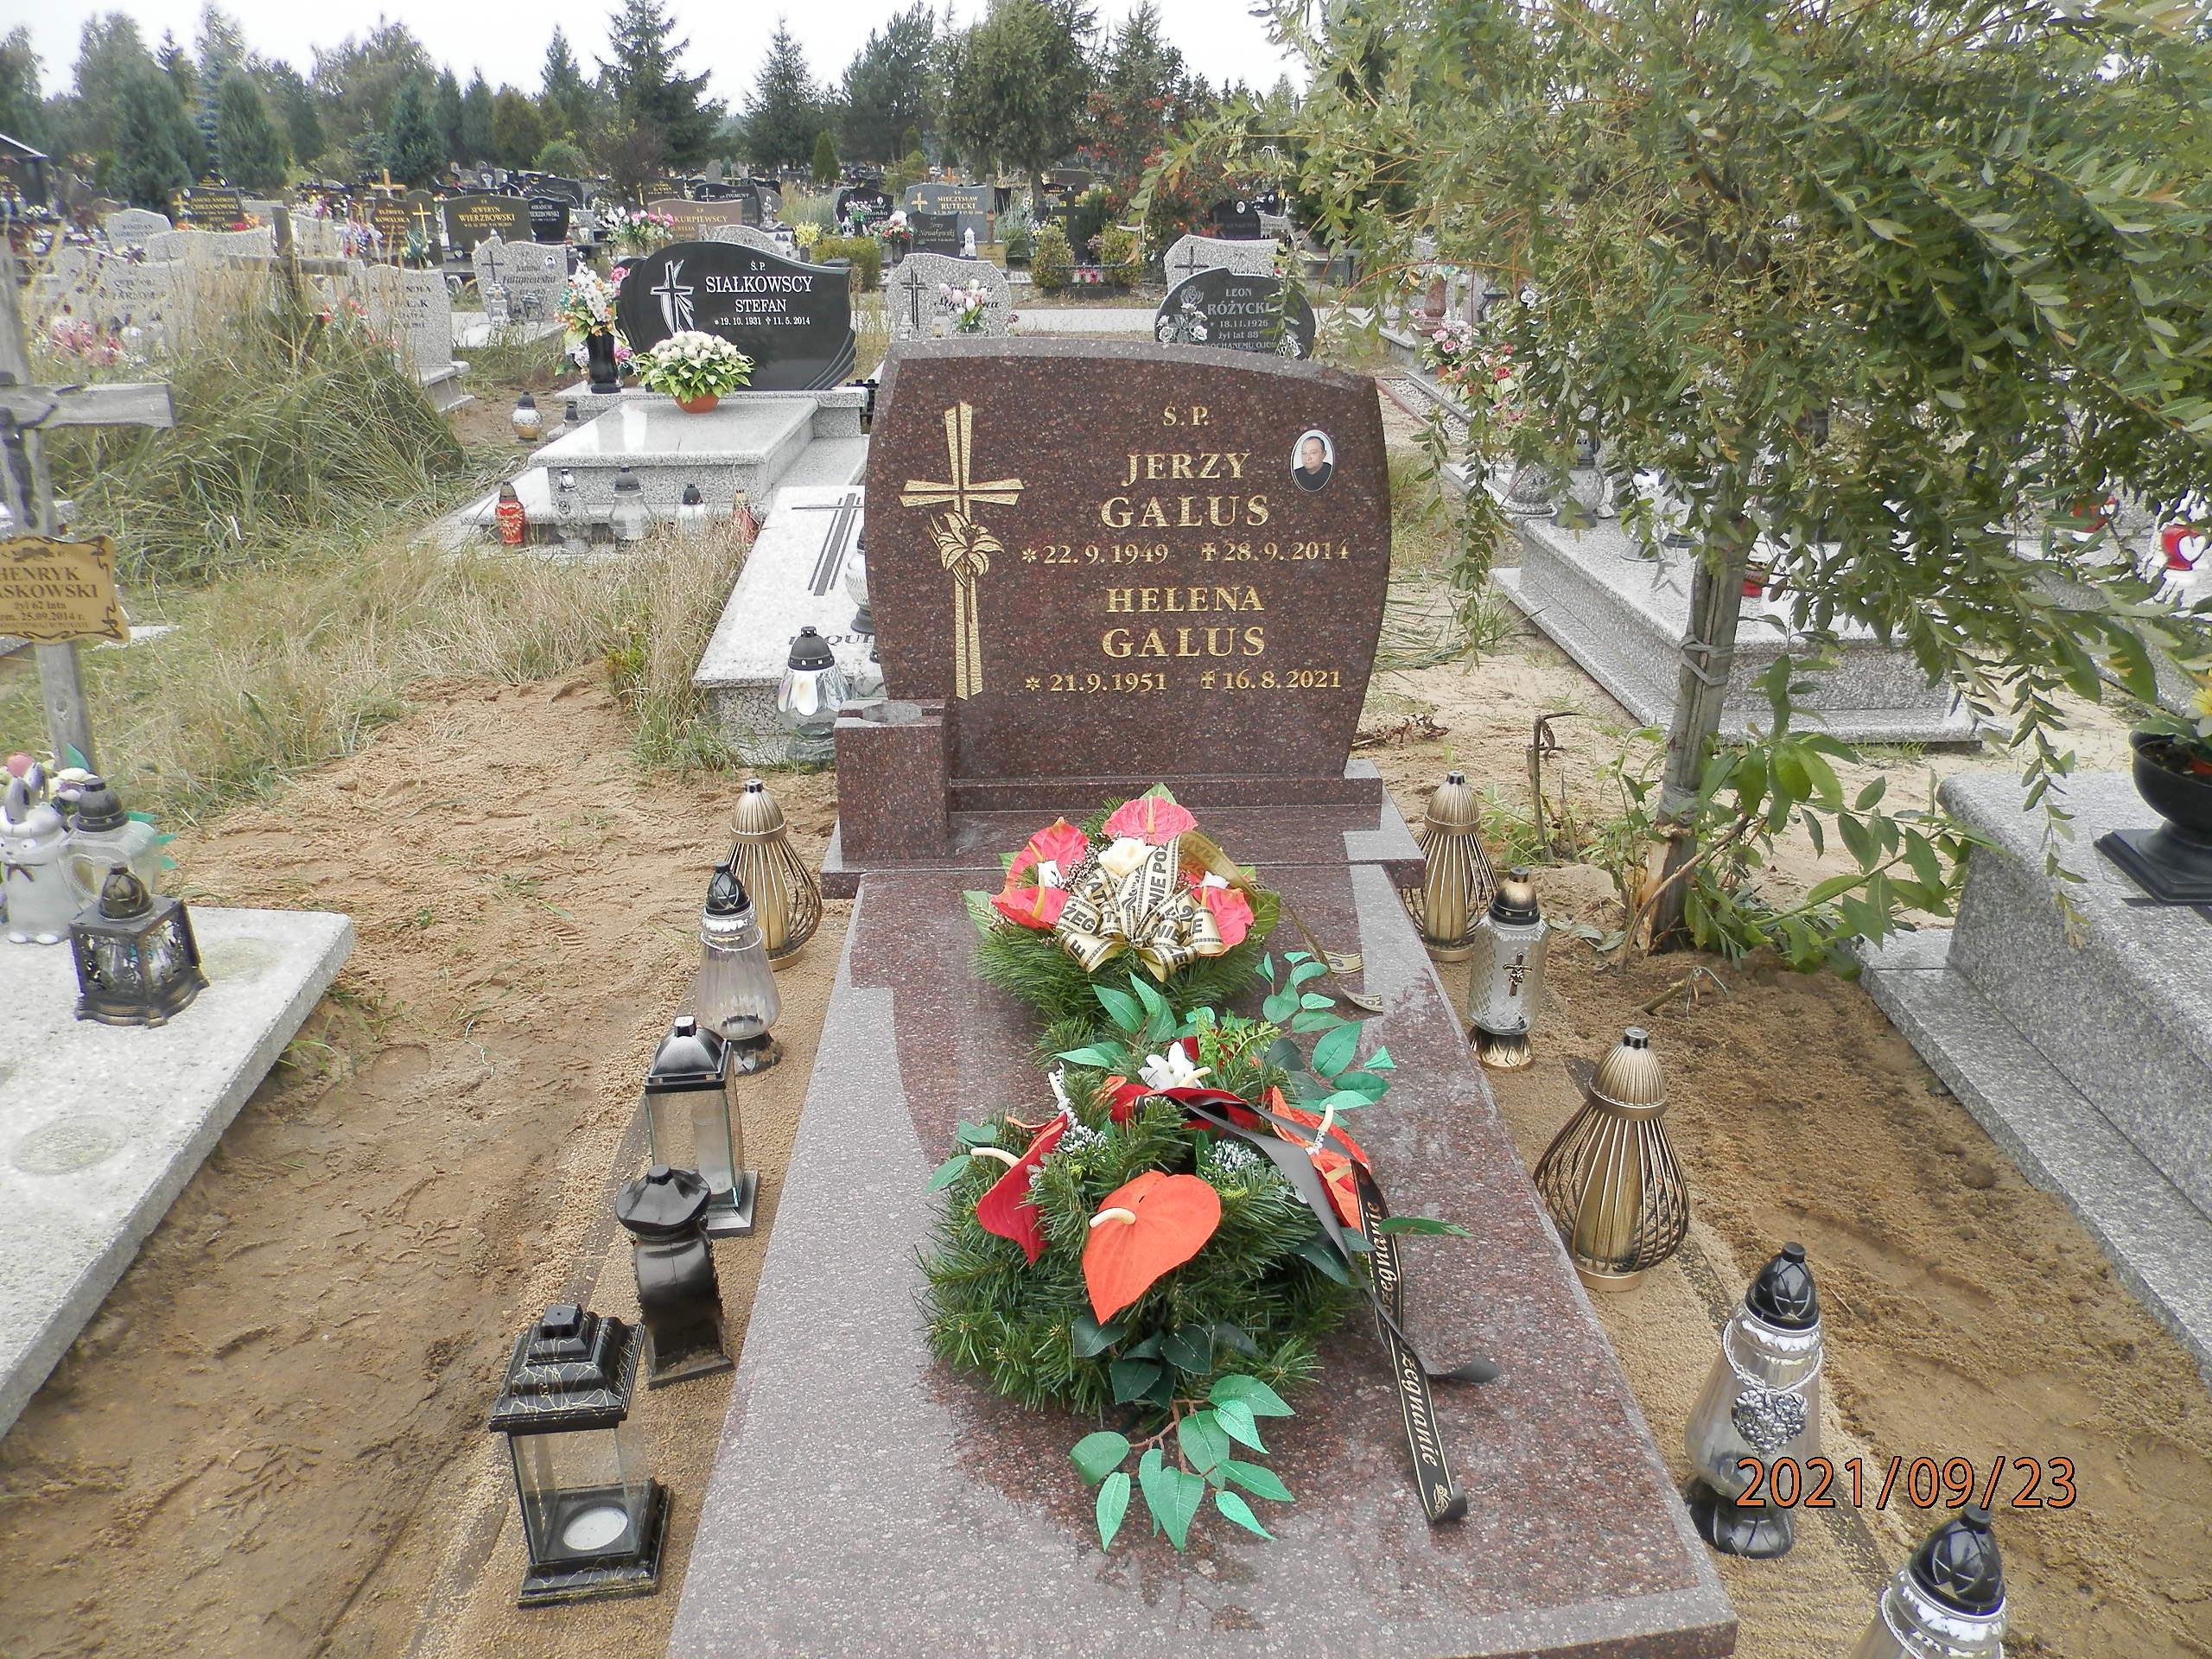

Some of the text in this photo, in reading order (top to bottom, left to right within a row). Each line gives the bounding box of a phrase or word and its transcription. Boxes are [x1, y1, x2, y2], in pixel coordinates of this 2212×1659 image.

[458, 213, 516, 222] WIERZBOWSKI
[1225, 288, 1252, 297] LEON
[735, 299, 786, 313] STEFAN
[1207, 300, 1270, 315] RÓŻYCKI
[1233, 331, 1244, 340] lat
[1247, 330, 1259, 339] 88
[1121, 452, 1252, 487] JERZY
[1100, 494, 1271, 529] GALUS
[1106, 586, 1265, 613] HELENA
[1101, 626, 1267, 658] GALUS
